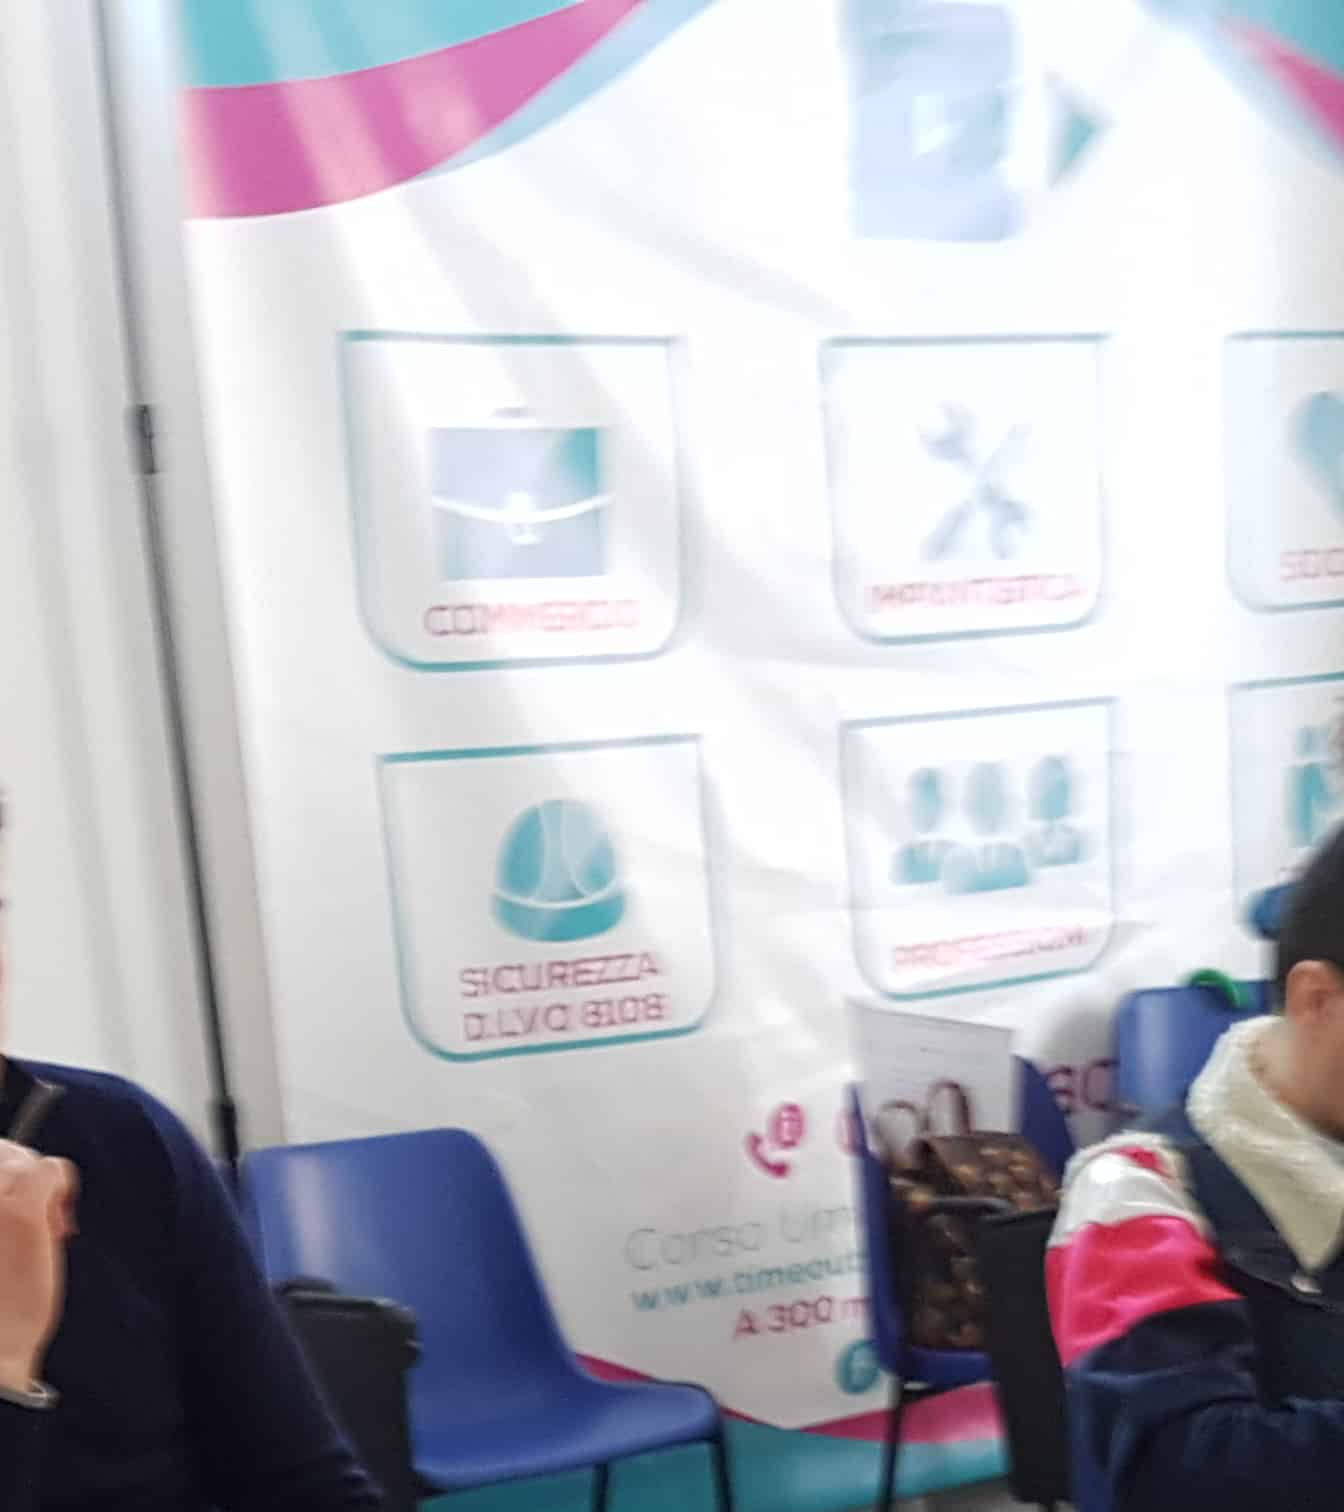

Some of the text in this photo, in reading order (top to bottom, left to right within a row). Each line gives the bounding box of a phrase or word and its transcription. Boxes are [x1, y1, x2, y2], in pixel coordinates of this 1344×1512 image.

[459, 952, 663, 998] SICUREZZA
[625, 1221, 764, 1271] Corso
[767, 1295, 833, 1333] 300
